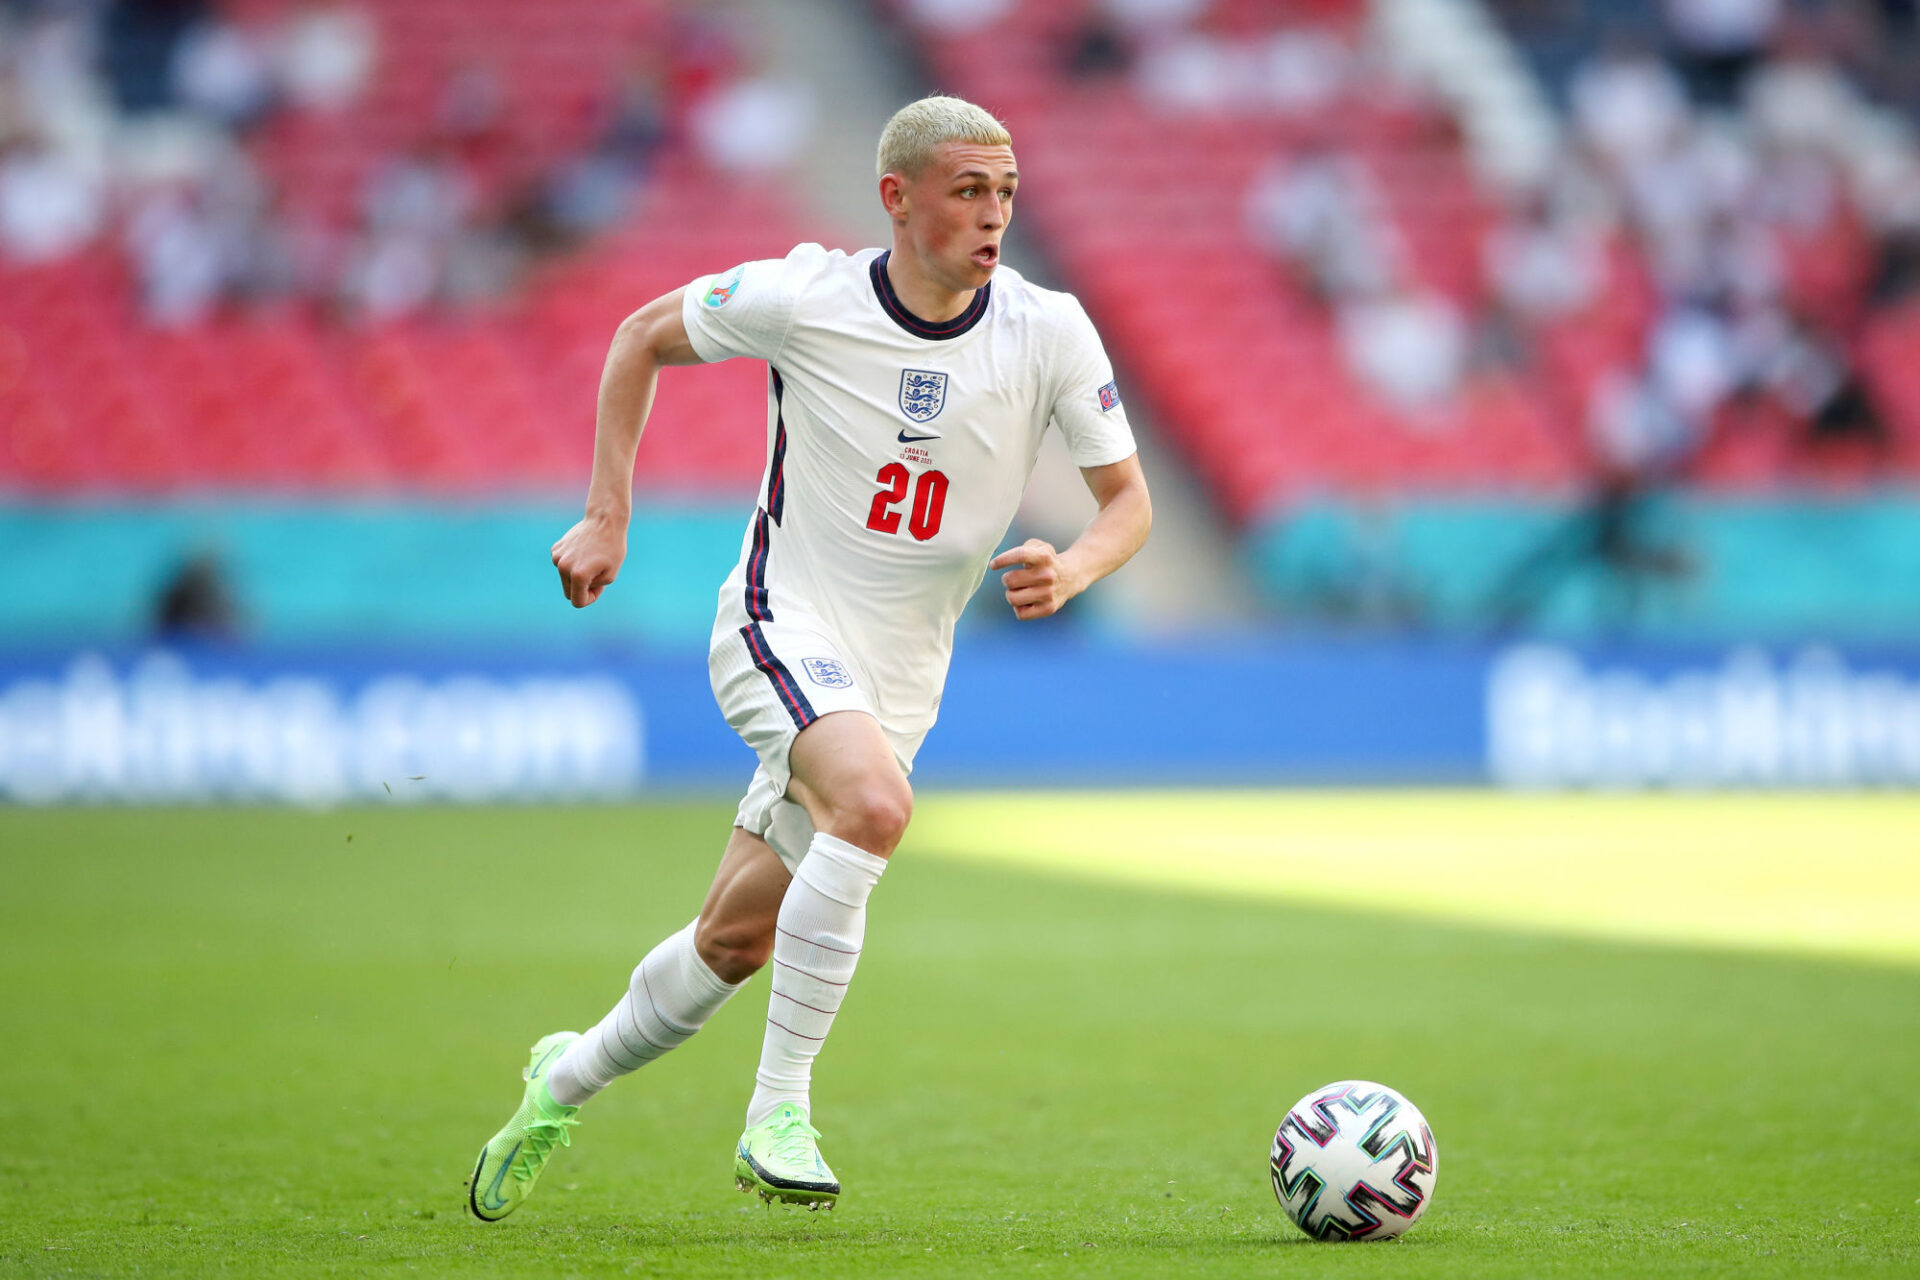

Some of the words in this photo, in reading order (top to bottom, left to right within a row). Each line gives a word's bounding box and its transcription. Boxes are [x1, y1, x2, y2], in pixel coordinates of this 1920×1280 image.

[904, 447, 929, 457] CROATIA
[905, 455, 920, 463] JUNE
[867, 462, 949, 541] 20
